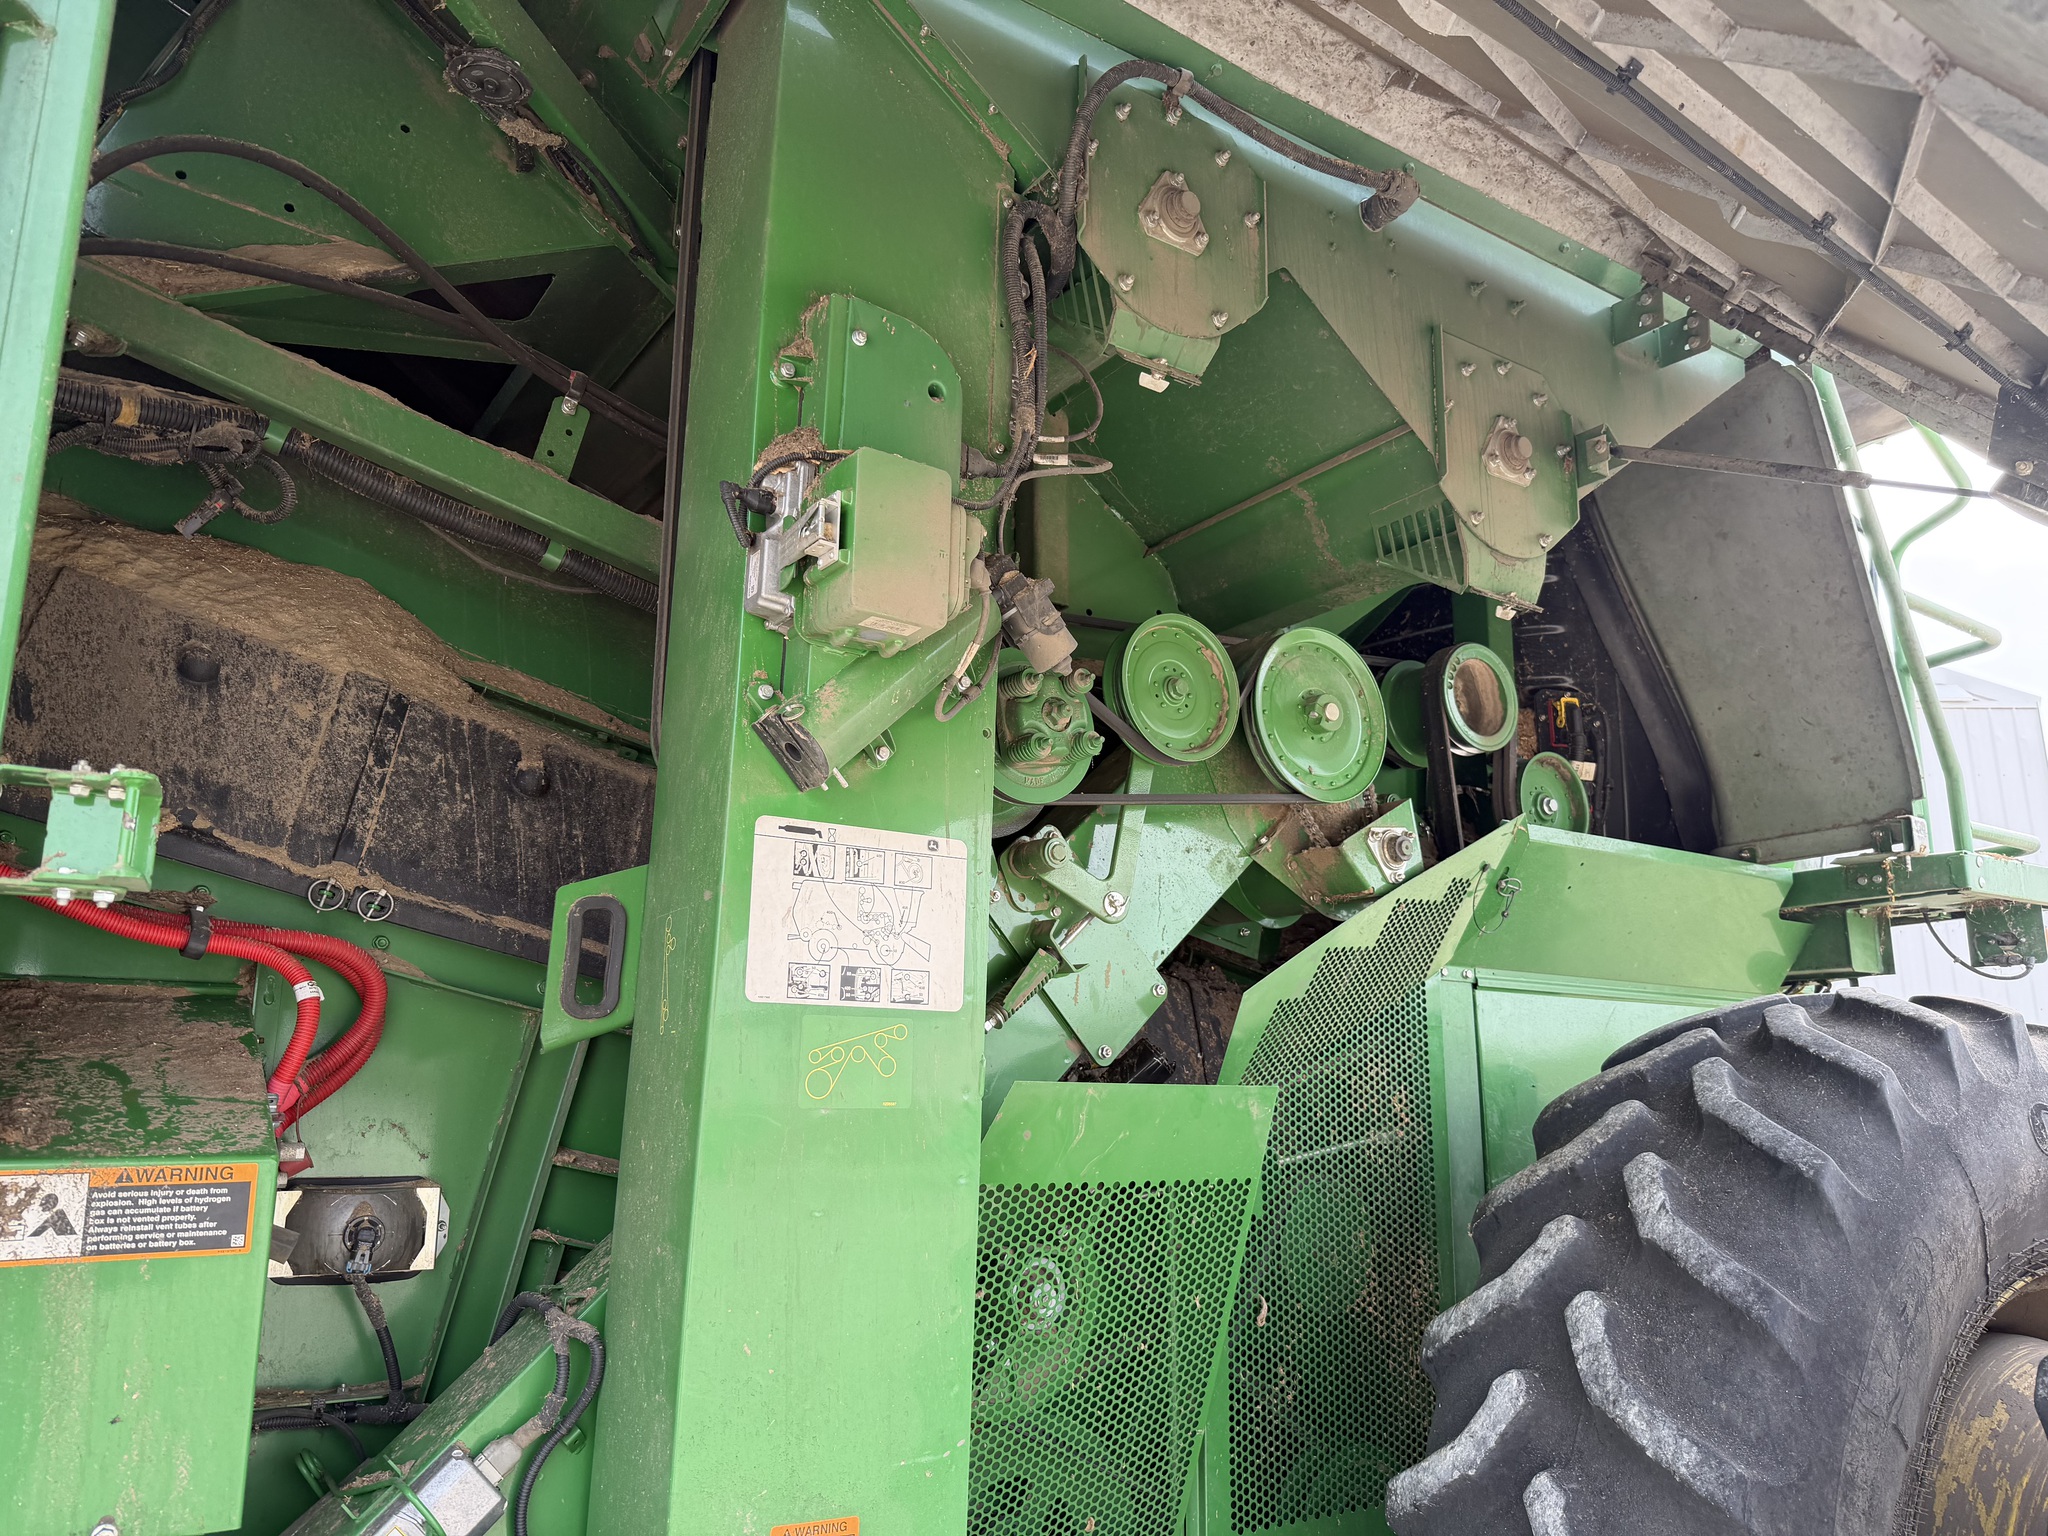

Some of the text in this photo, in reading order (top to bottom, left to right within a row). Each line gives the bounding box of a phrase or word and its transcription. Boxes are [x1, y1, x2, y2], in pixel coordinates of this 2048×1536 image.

[136, 1166, 234, 1182] WARNING
[150, 1189, 174, 1197] injury
[91, 1200, 134, 1208] explosion.
[194, 1196, 231, 1204] hydrogen
[90, 1209, 105, 1217] gas
[180, 1205, 208, 1213] battery
[162, 1214, 196, 1222] properly.
[88, 1225, 118, 1234] Always
[87, 1234, 132, 1243] performing
[99, 1242, 136, 1250] batteries
[149, 1240, 178, 1249] battery
[795, 1521, 847, 1536] WARNING
